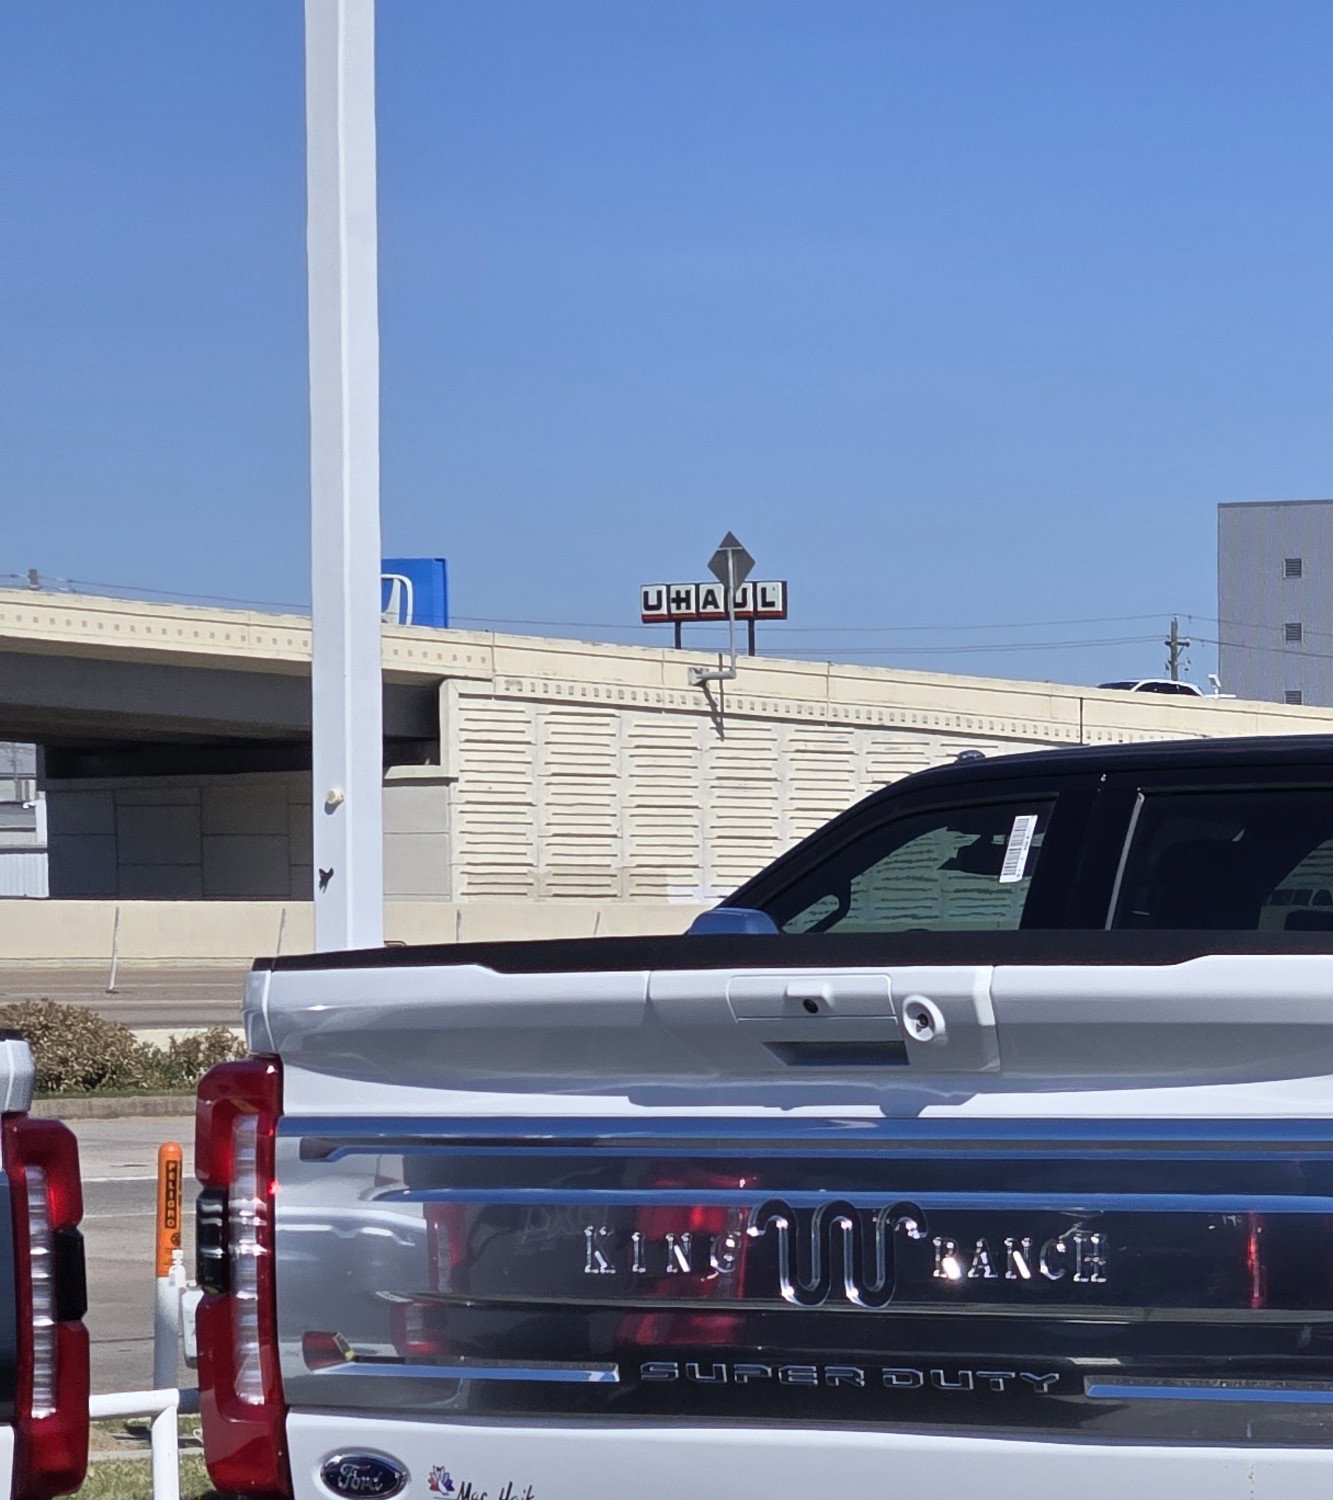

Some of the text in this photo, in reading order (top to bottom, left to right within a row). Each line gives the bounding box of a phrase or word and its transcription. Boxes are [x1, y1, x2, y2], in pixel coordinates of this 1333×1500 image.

[167, 1162, 176, 1227] PELIGRO
[584, 1225, 1107, 1283] KING RANCH
[640, 1361, 1060, 1393] SUPER DUTY
[338, 1463, 385, 1492] Ford
